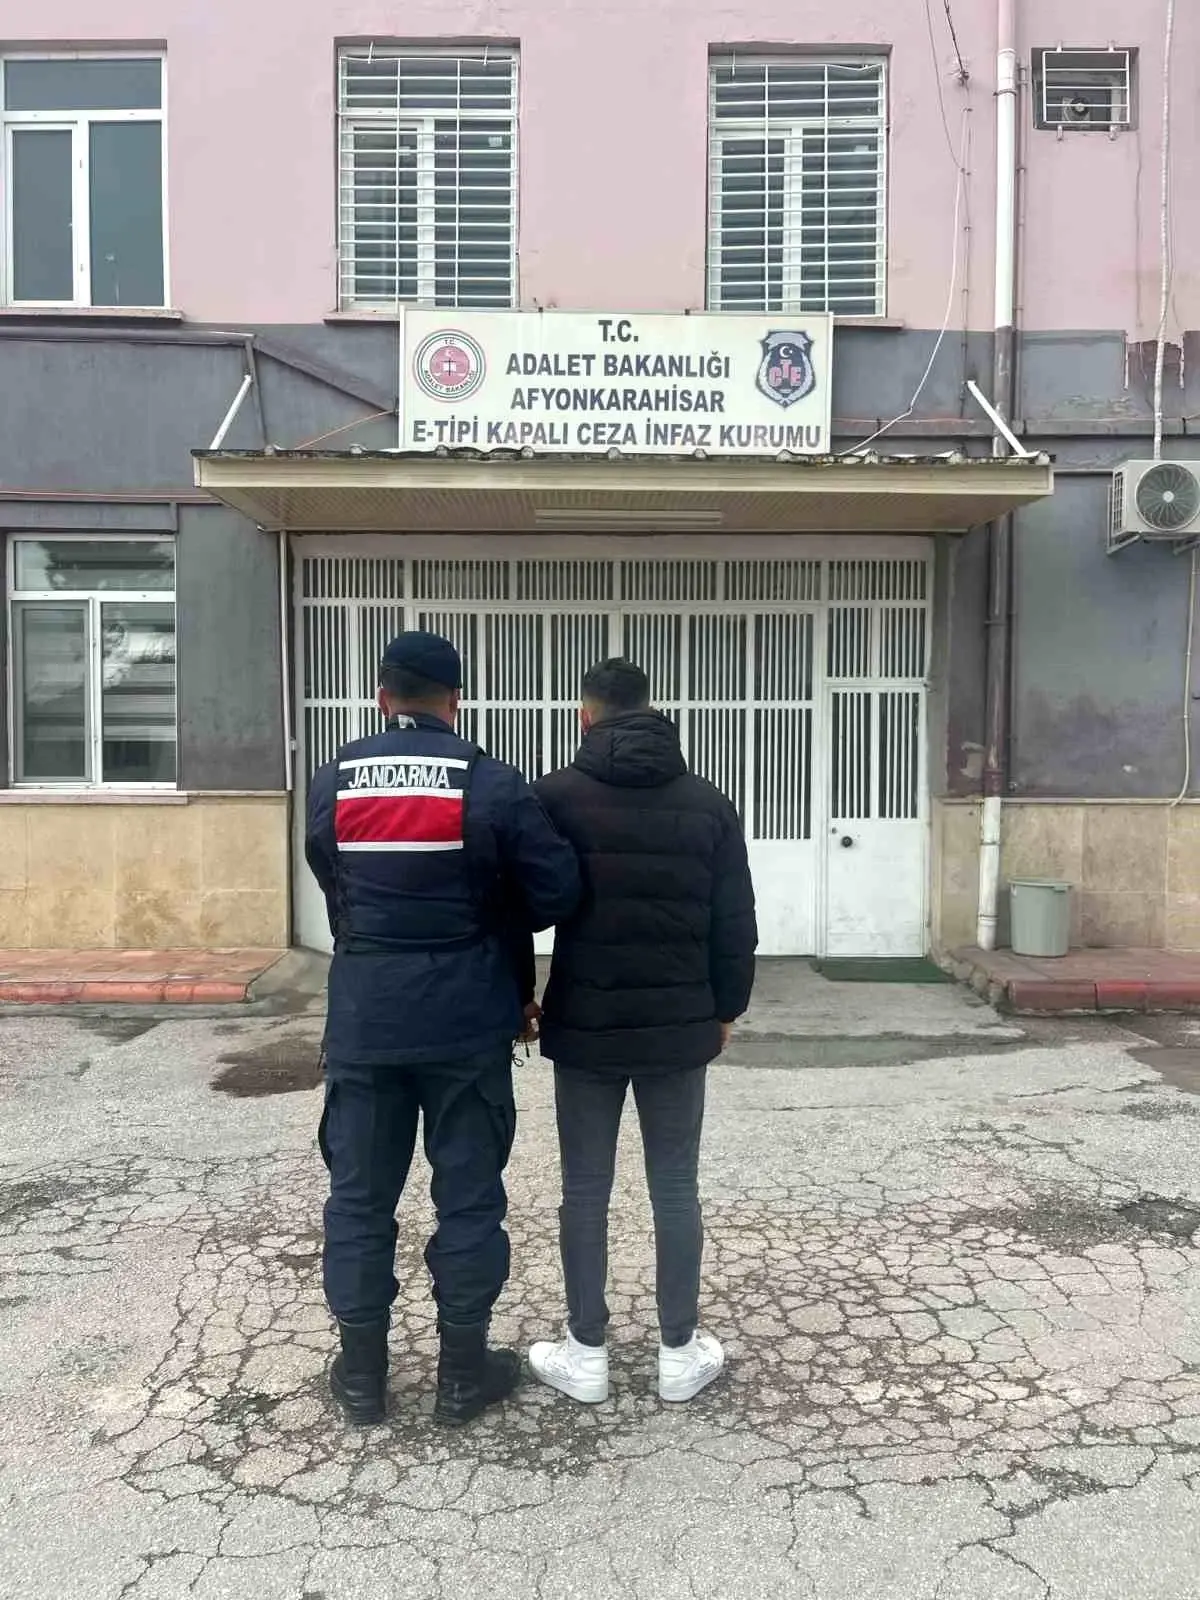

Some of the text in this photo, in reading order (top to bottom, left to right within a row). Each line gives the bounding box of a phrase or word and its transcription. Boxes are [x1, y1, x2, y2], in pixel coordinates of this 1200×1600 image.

[598, 320, 639, 342] T.C.
[506, 351, 730, 378] ADALET BAKANLIĞI
[768, 359, 802, 387] CTE
[510, 384, 725, 412] AFYONKARAHİSAR
[413, 415, 821, 448] E-TİPİ KAPALI CEZA İNFAZ KURUMU
[348, 765, 450, 789] JANDARMA
